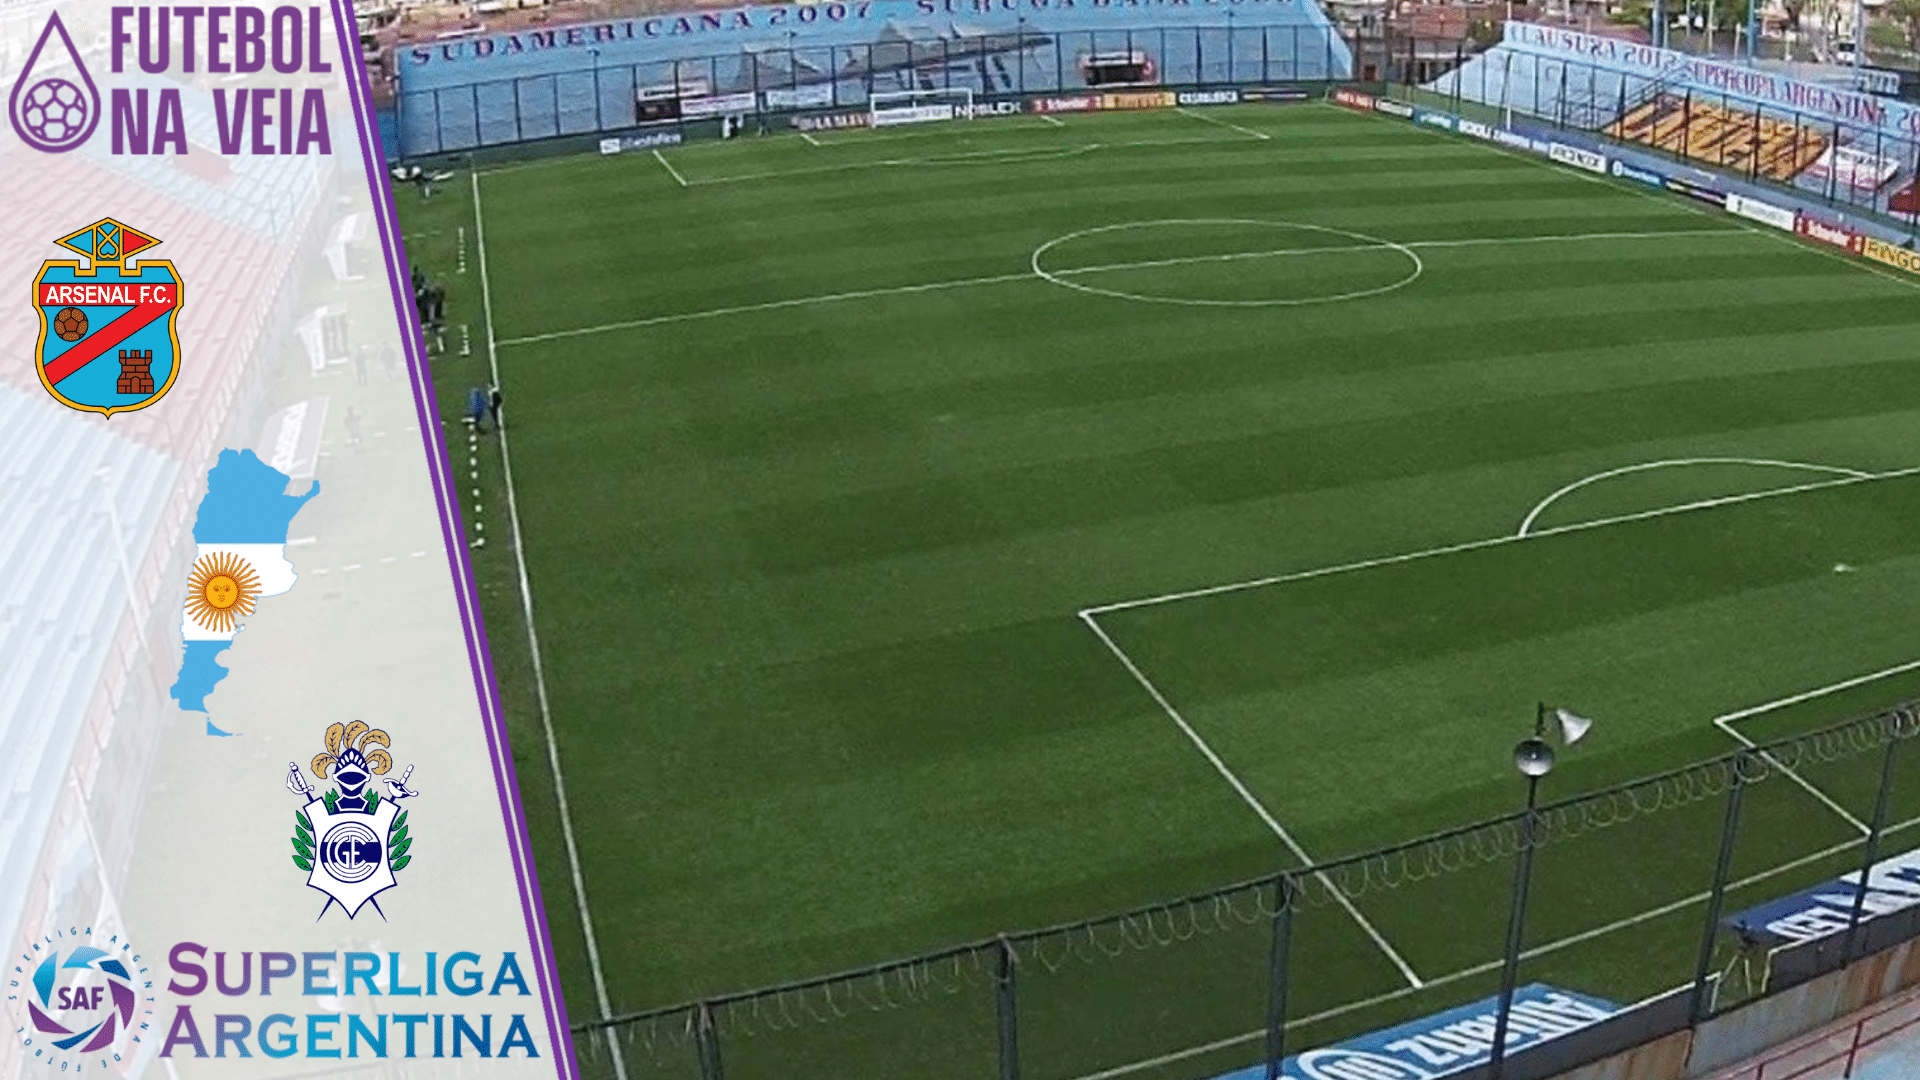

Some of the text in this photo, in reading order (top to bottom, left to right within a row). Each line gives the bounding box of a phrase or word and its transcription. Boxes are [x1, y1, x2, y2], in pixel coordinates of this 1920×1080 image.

[411, 11, 752, 65] SUDAMERICANA
[770, 2, 873, 26] 2007
[1510, 25, 1677, 70] CLAUSURA 2012
